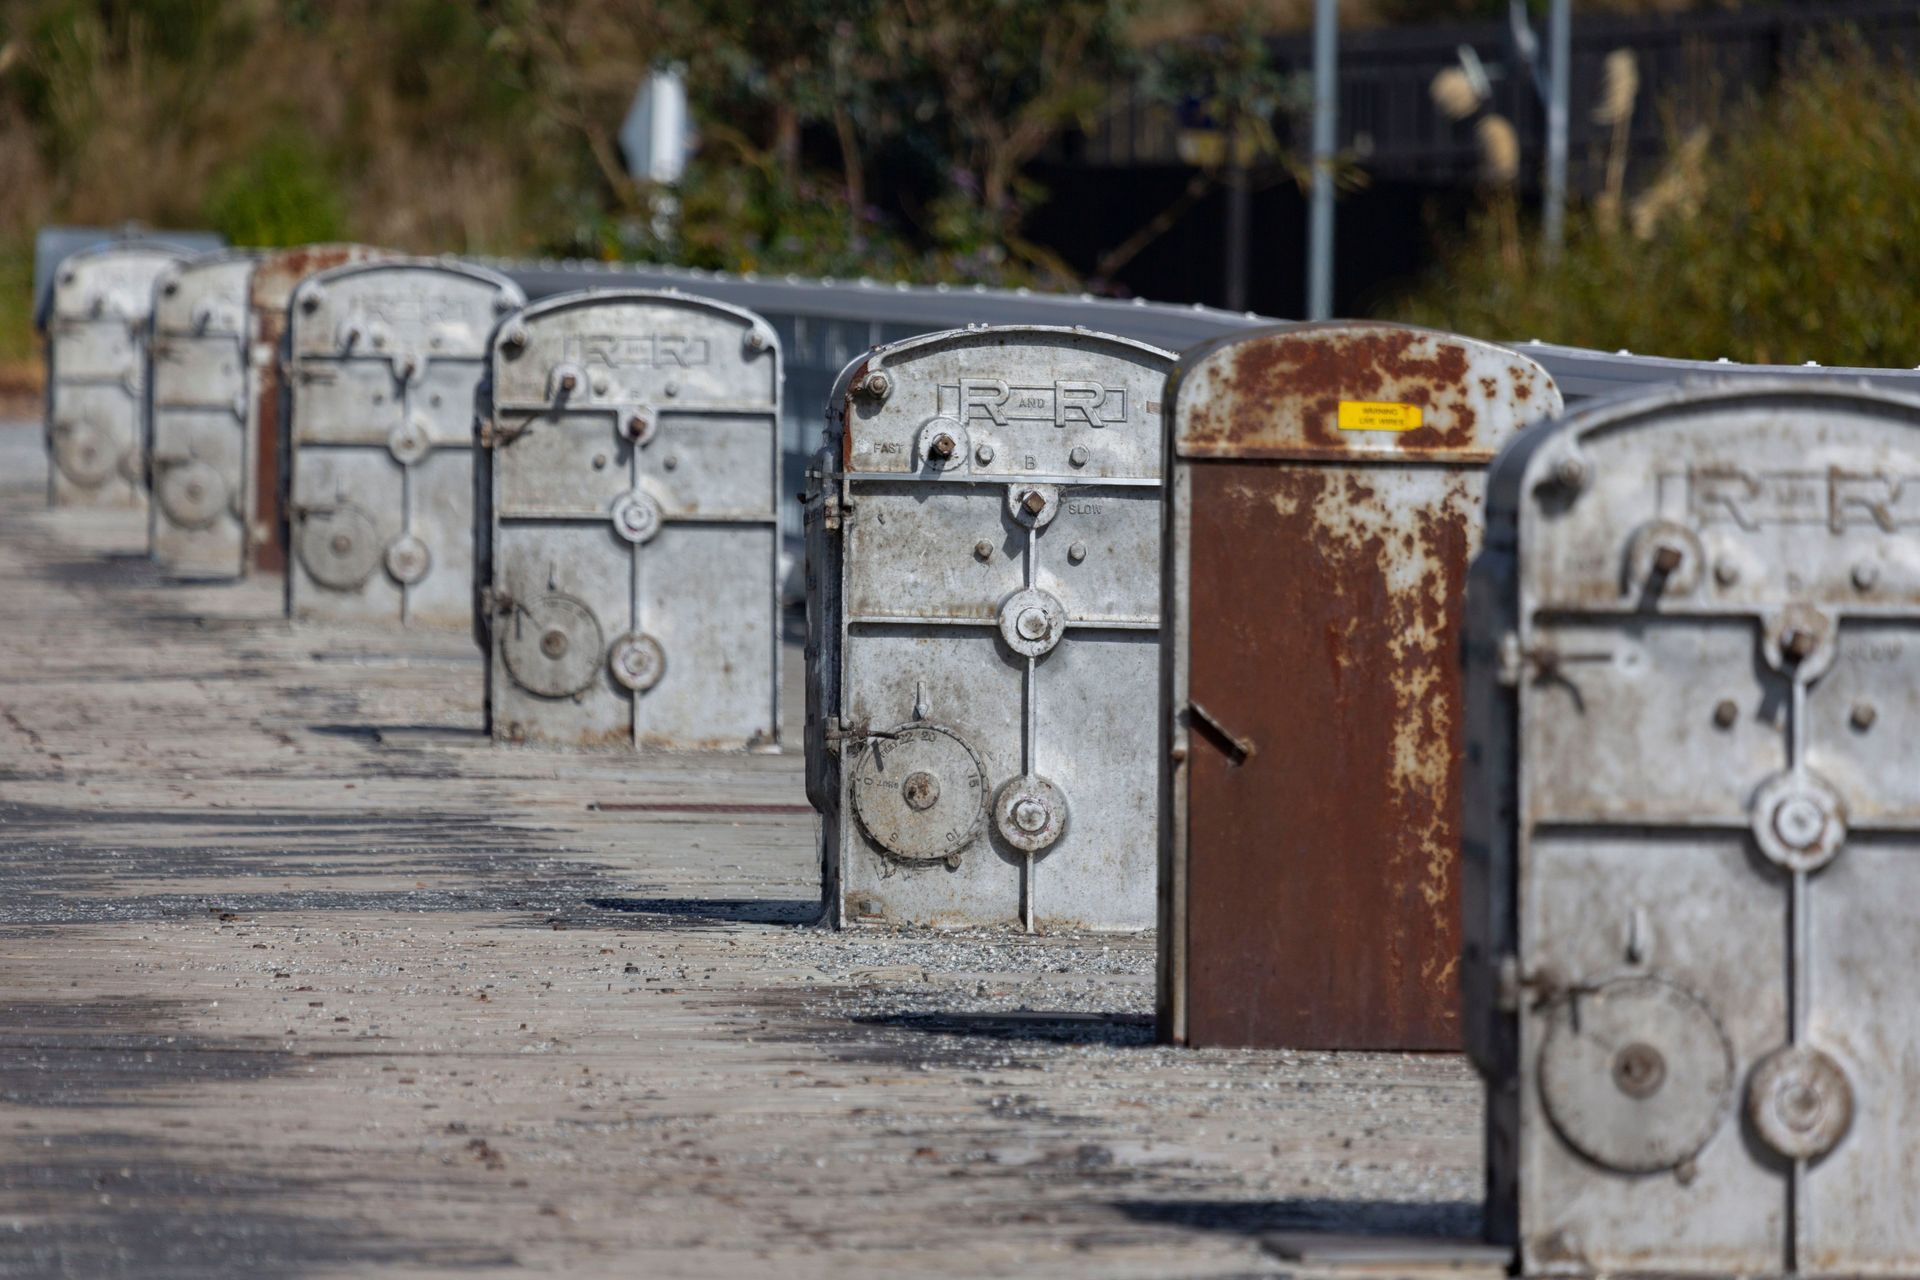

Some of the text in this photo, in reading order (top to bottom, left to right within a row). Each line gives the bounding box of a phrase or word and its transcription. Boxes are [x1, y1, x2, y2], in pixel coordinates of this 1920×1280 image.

[959, 378, 1106, 428] R AND R
[873, 442, 904, 454] FAST
[1827, 464, 1905, 535] R
[1068, 504, 1102, 516] SLOW
[920, 731, 938, 743] 20
[967, 772, 980, 788] 15
[945, 828, 962, 842] 10
